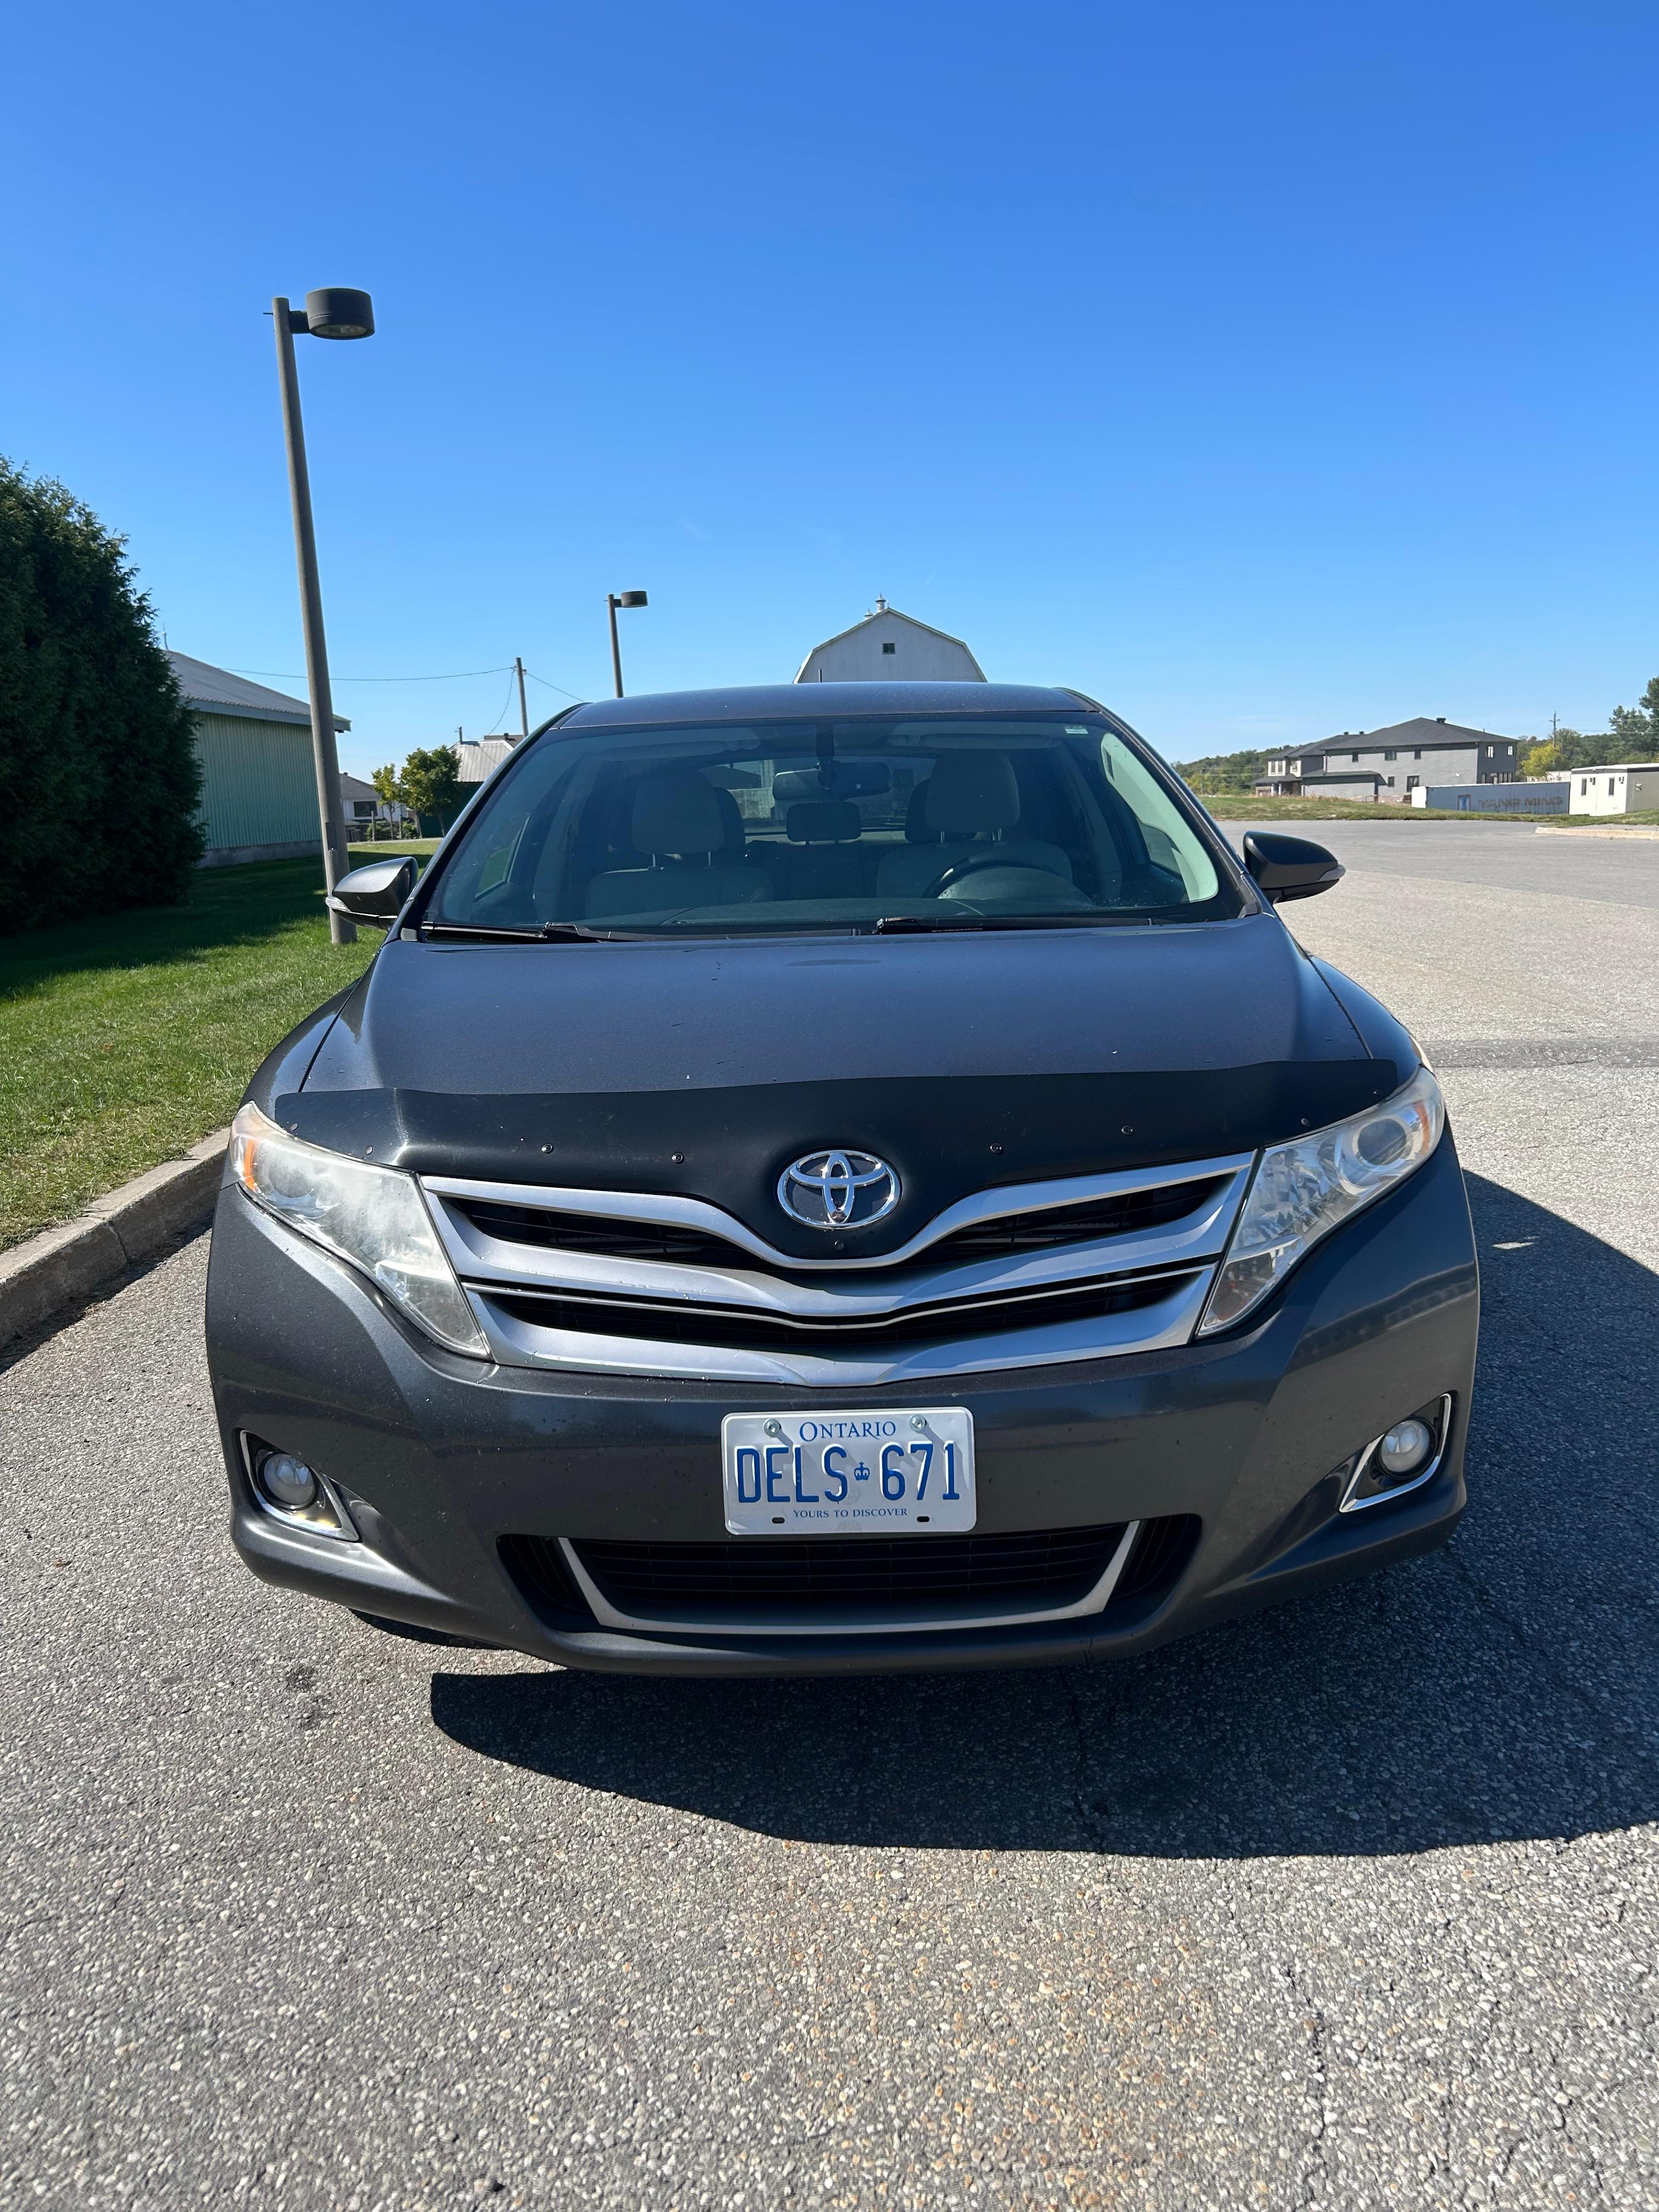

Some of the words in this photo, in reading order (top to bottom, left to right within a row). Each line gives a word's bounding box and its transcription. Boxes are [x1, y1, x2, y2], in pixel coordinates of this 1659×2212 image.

[1525, 797, 1563, 806] MING
[799, 1421, 896, 1442] ONTARIO
[736, 1445, 848, 1503] DELS
[882, 1443, 960, 1500] 671
[793, 1510, 829, 1518] YOURS
[834, 1510, 849, 1518] TO
[853, 1508, 907, 1517] DISCOVER
